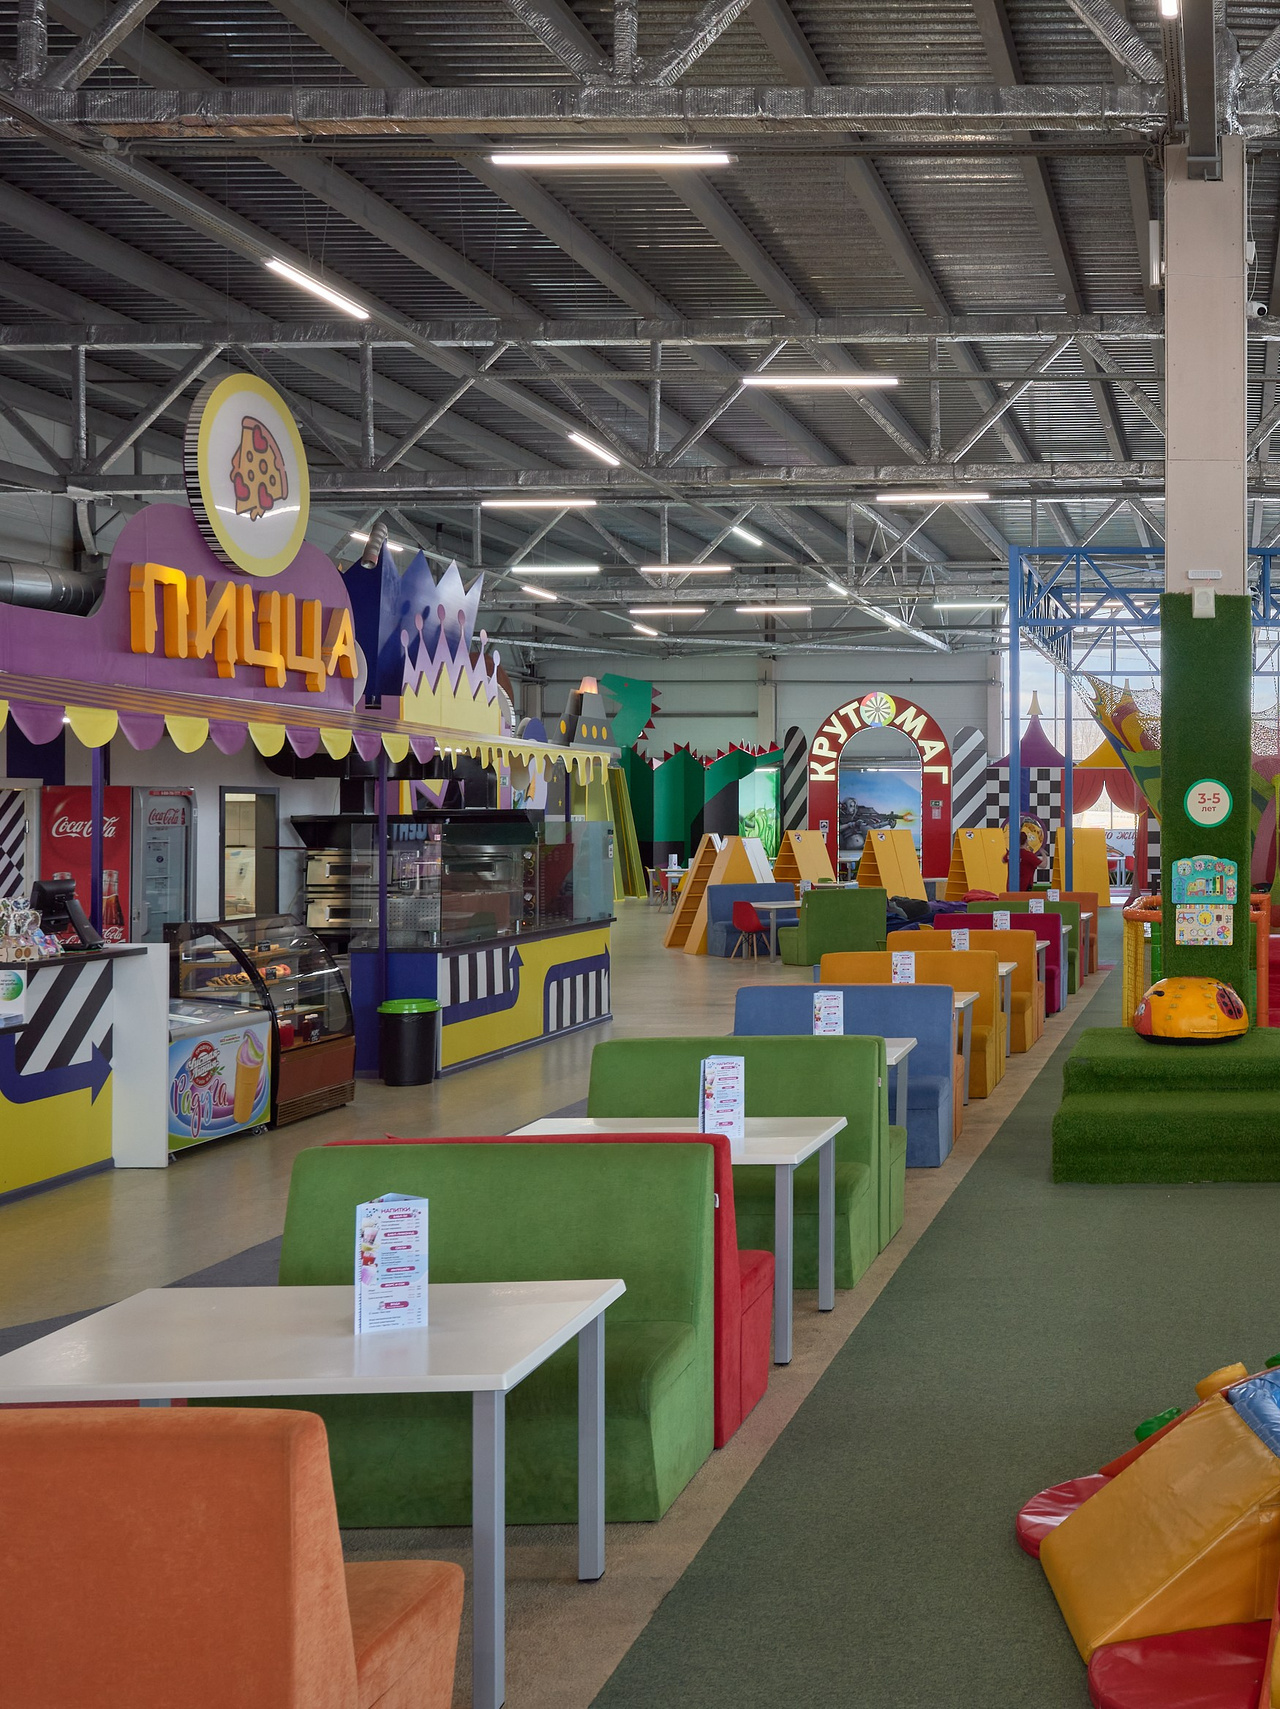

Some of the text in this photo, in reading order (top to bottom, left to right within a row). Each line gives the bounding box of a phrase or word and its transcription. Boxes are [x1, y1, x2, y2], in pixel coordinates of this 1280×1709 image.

[130, 562, 359, 693] ПИЦЦА
[1198, 793, 1221, 804] 3-5
[52, 816, 120, 838] Coca-Cla
[148, 808, 180, 826] Coca-Cola
[173, 1073, 228, 1138] Радуга
